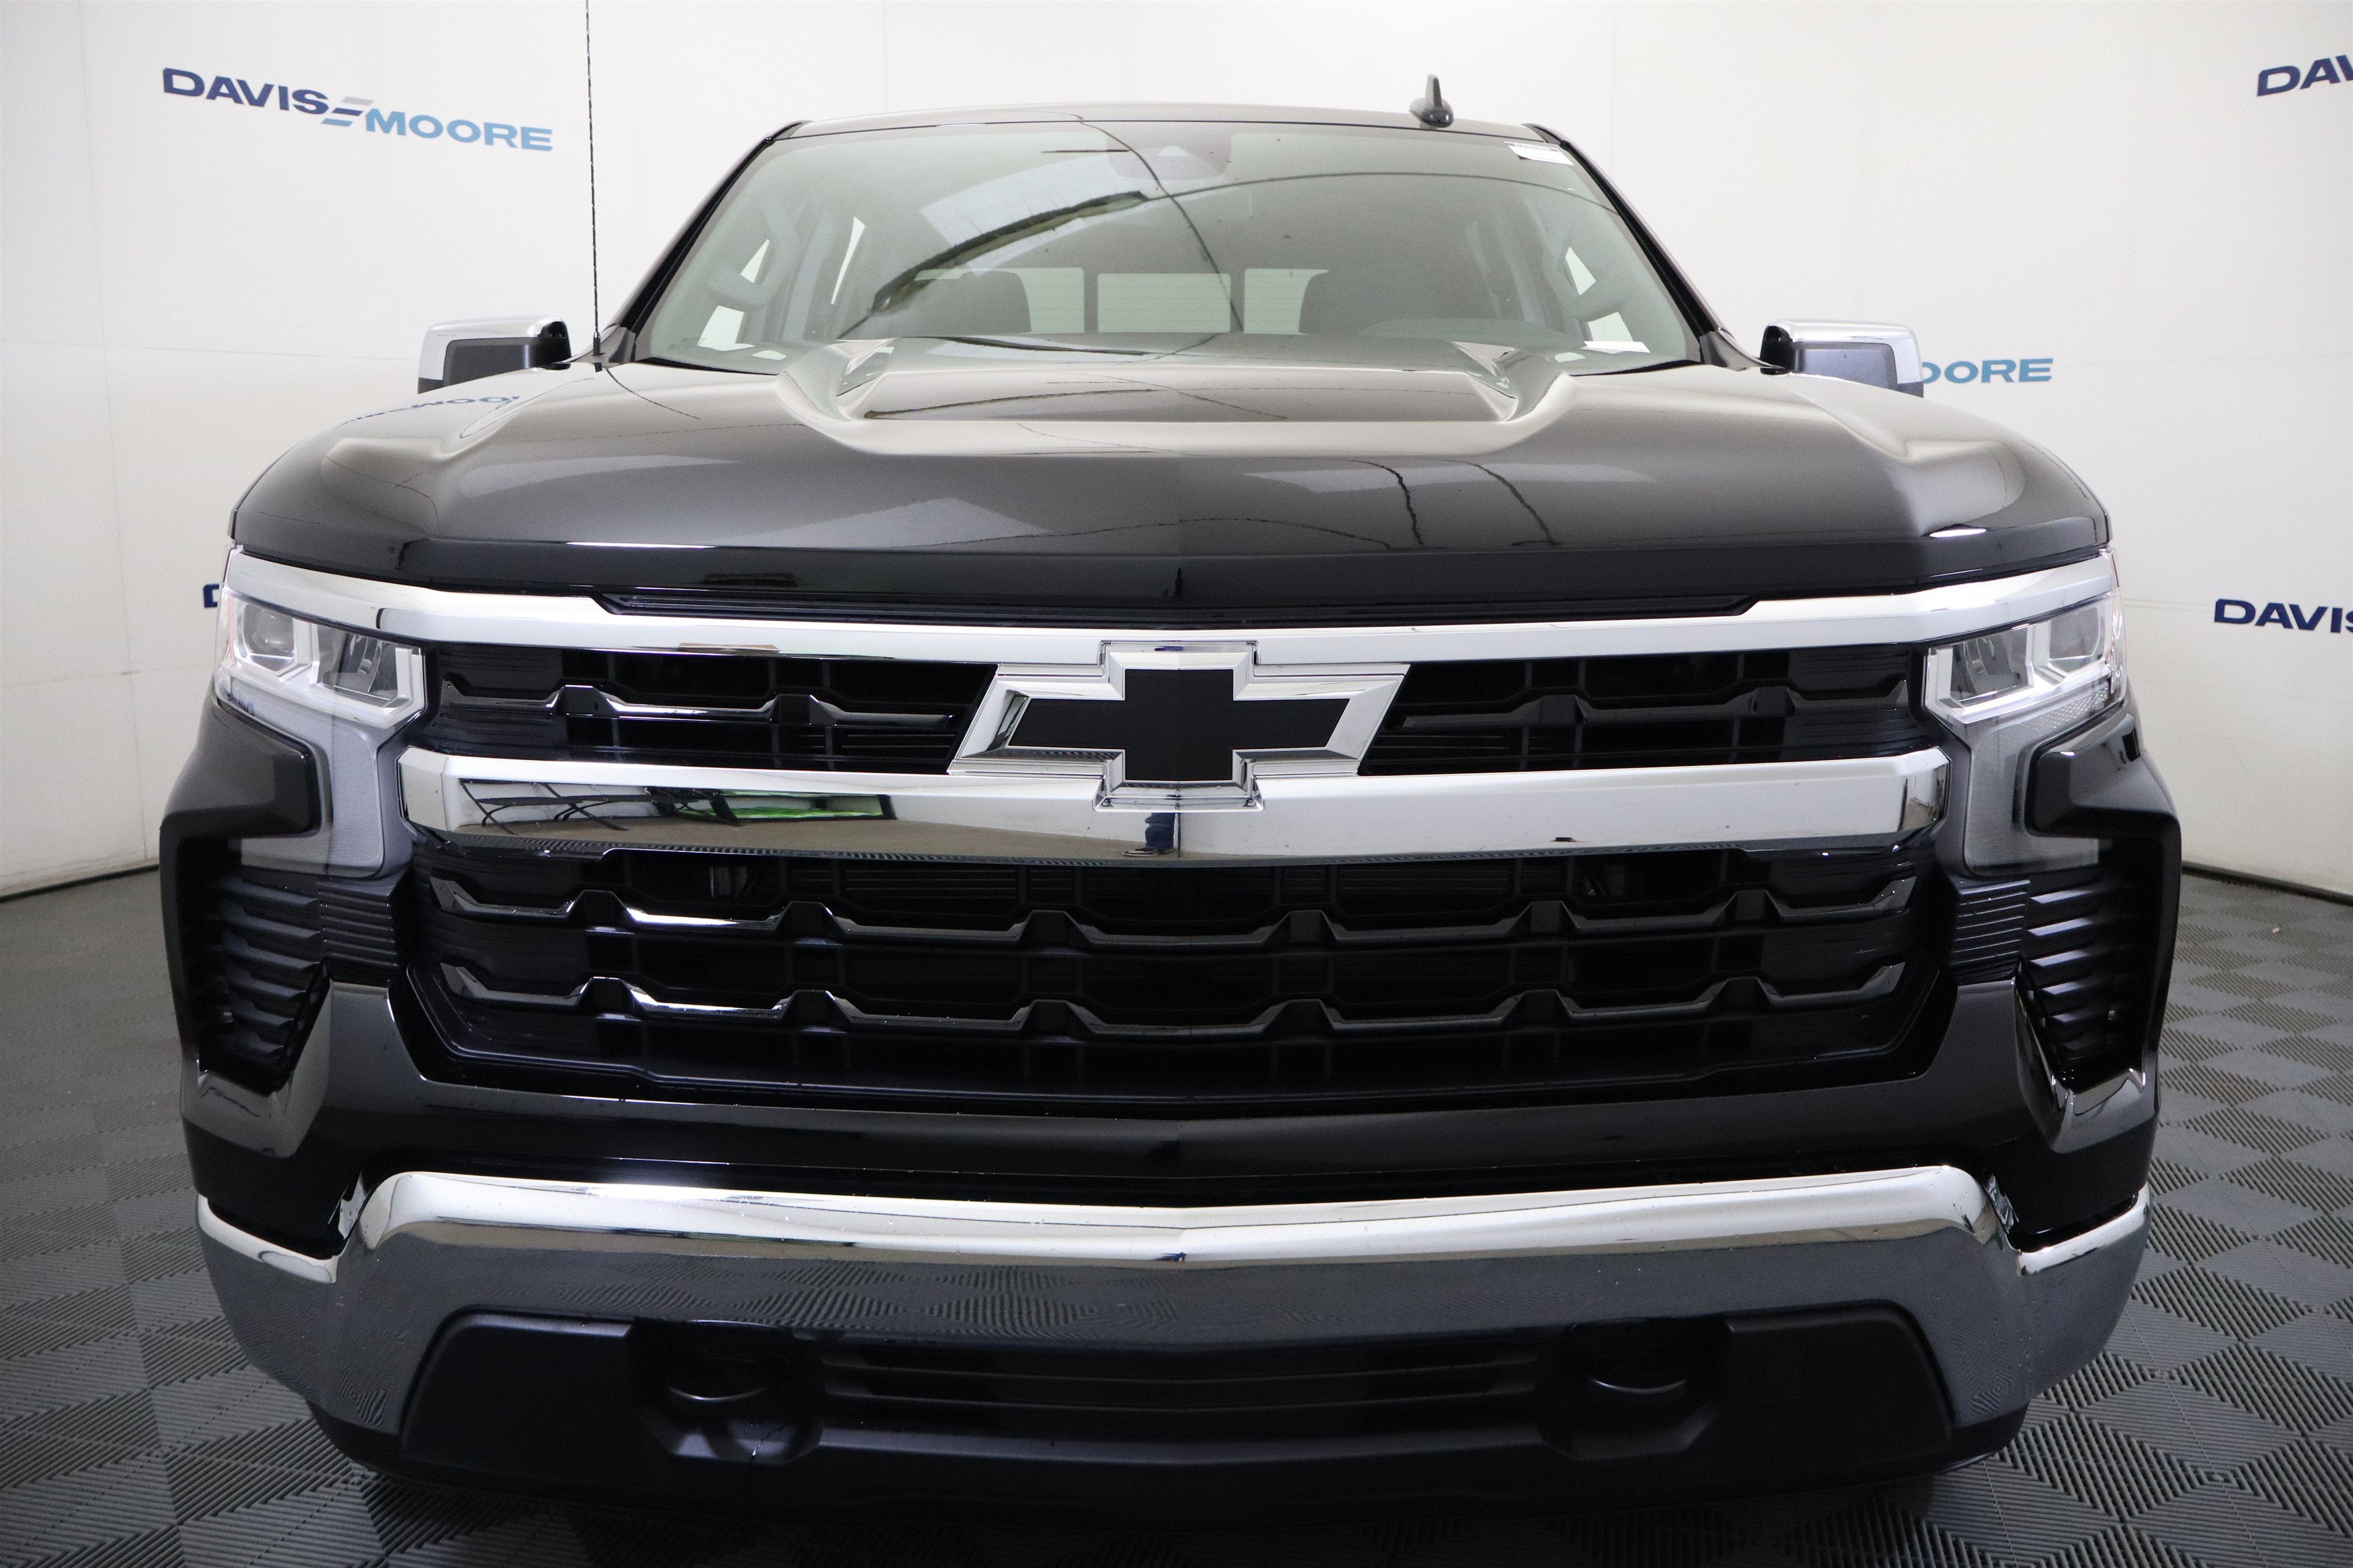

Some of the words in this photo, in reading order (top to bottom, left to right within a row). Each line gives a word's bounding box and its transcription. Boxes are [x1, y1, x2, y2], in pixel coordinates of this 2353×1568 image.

[163, 67, 329, 114] DAVIS
[367, 108, 553, 152] MOORE
[2214, 598, 2353, 634] DAVI
